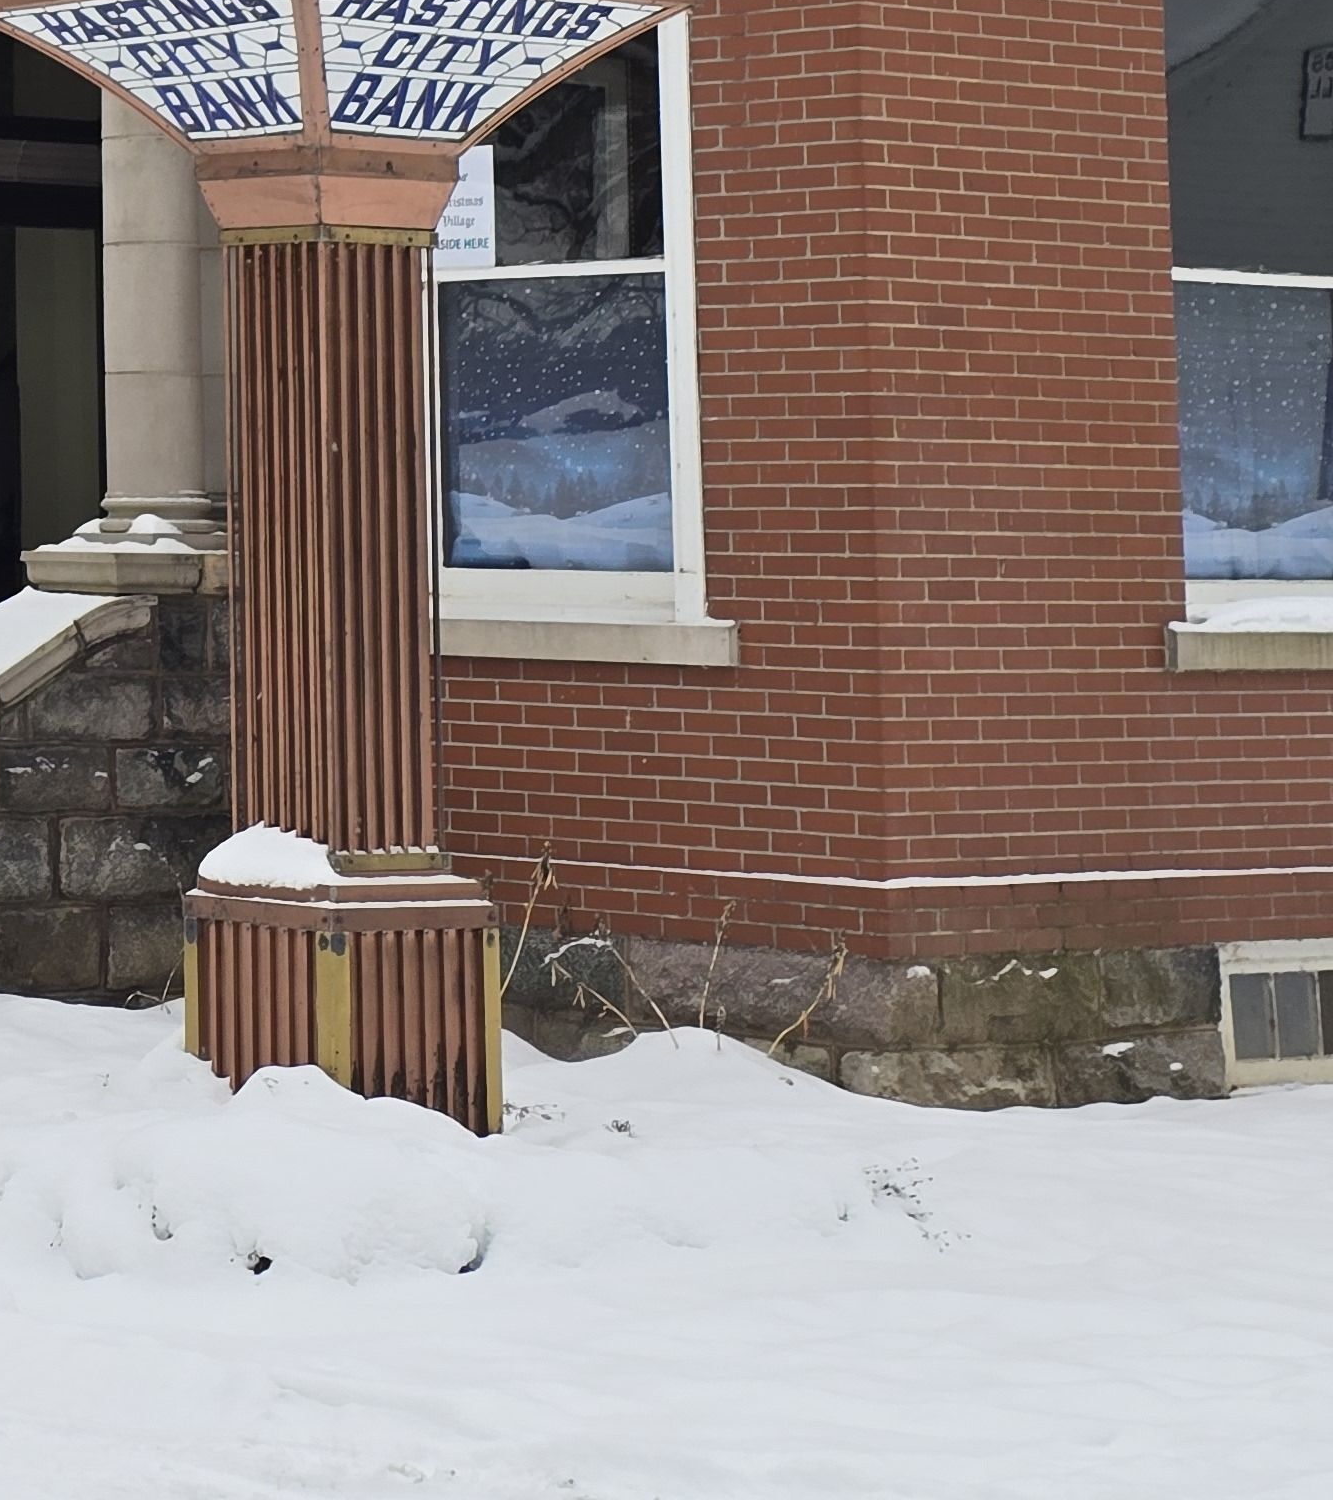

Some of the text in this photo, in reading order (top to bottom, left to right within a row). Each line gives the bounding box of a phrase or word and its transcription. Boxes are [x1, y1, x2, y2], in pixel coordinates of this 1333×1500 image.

[125, 32, 248, 78] CITY
[372, 30, 520, 75] CITY
[155, 73, 302, 131] BANK
[332, 72, 496, 131] BANK
[464, 237, 489, 249] HERE
